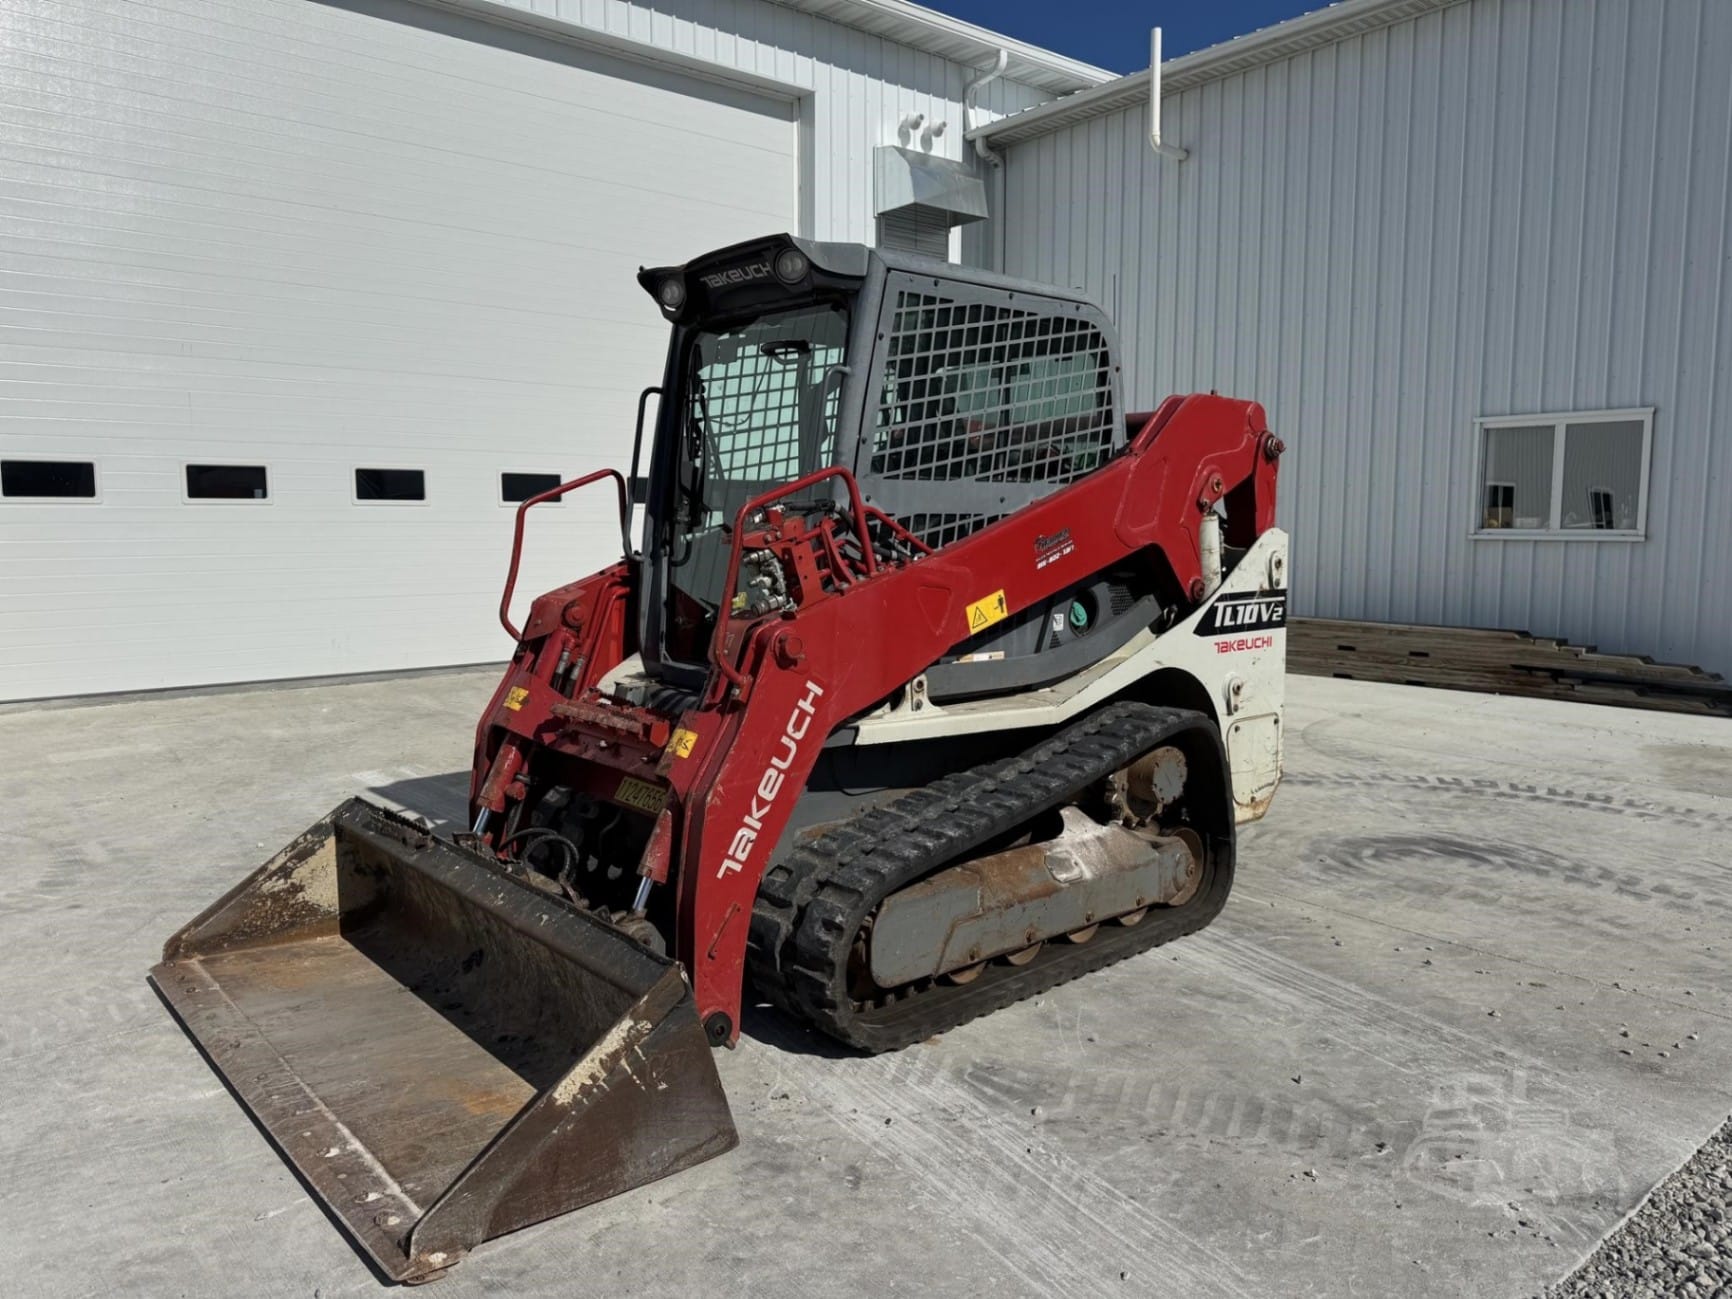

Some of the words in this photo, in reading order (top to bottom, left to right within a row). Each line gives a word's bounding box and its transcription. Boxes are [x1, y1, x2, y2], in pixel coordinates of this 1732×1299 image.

[699, 262, 773, 288] TAKEUCH
[1213, 600, 1283, 628] TL10V2
[1214, 636, 1273, 654] TAKEUCHI
